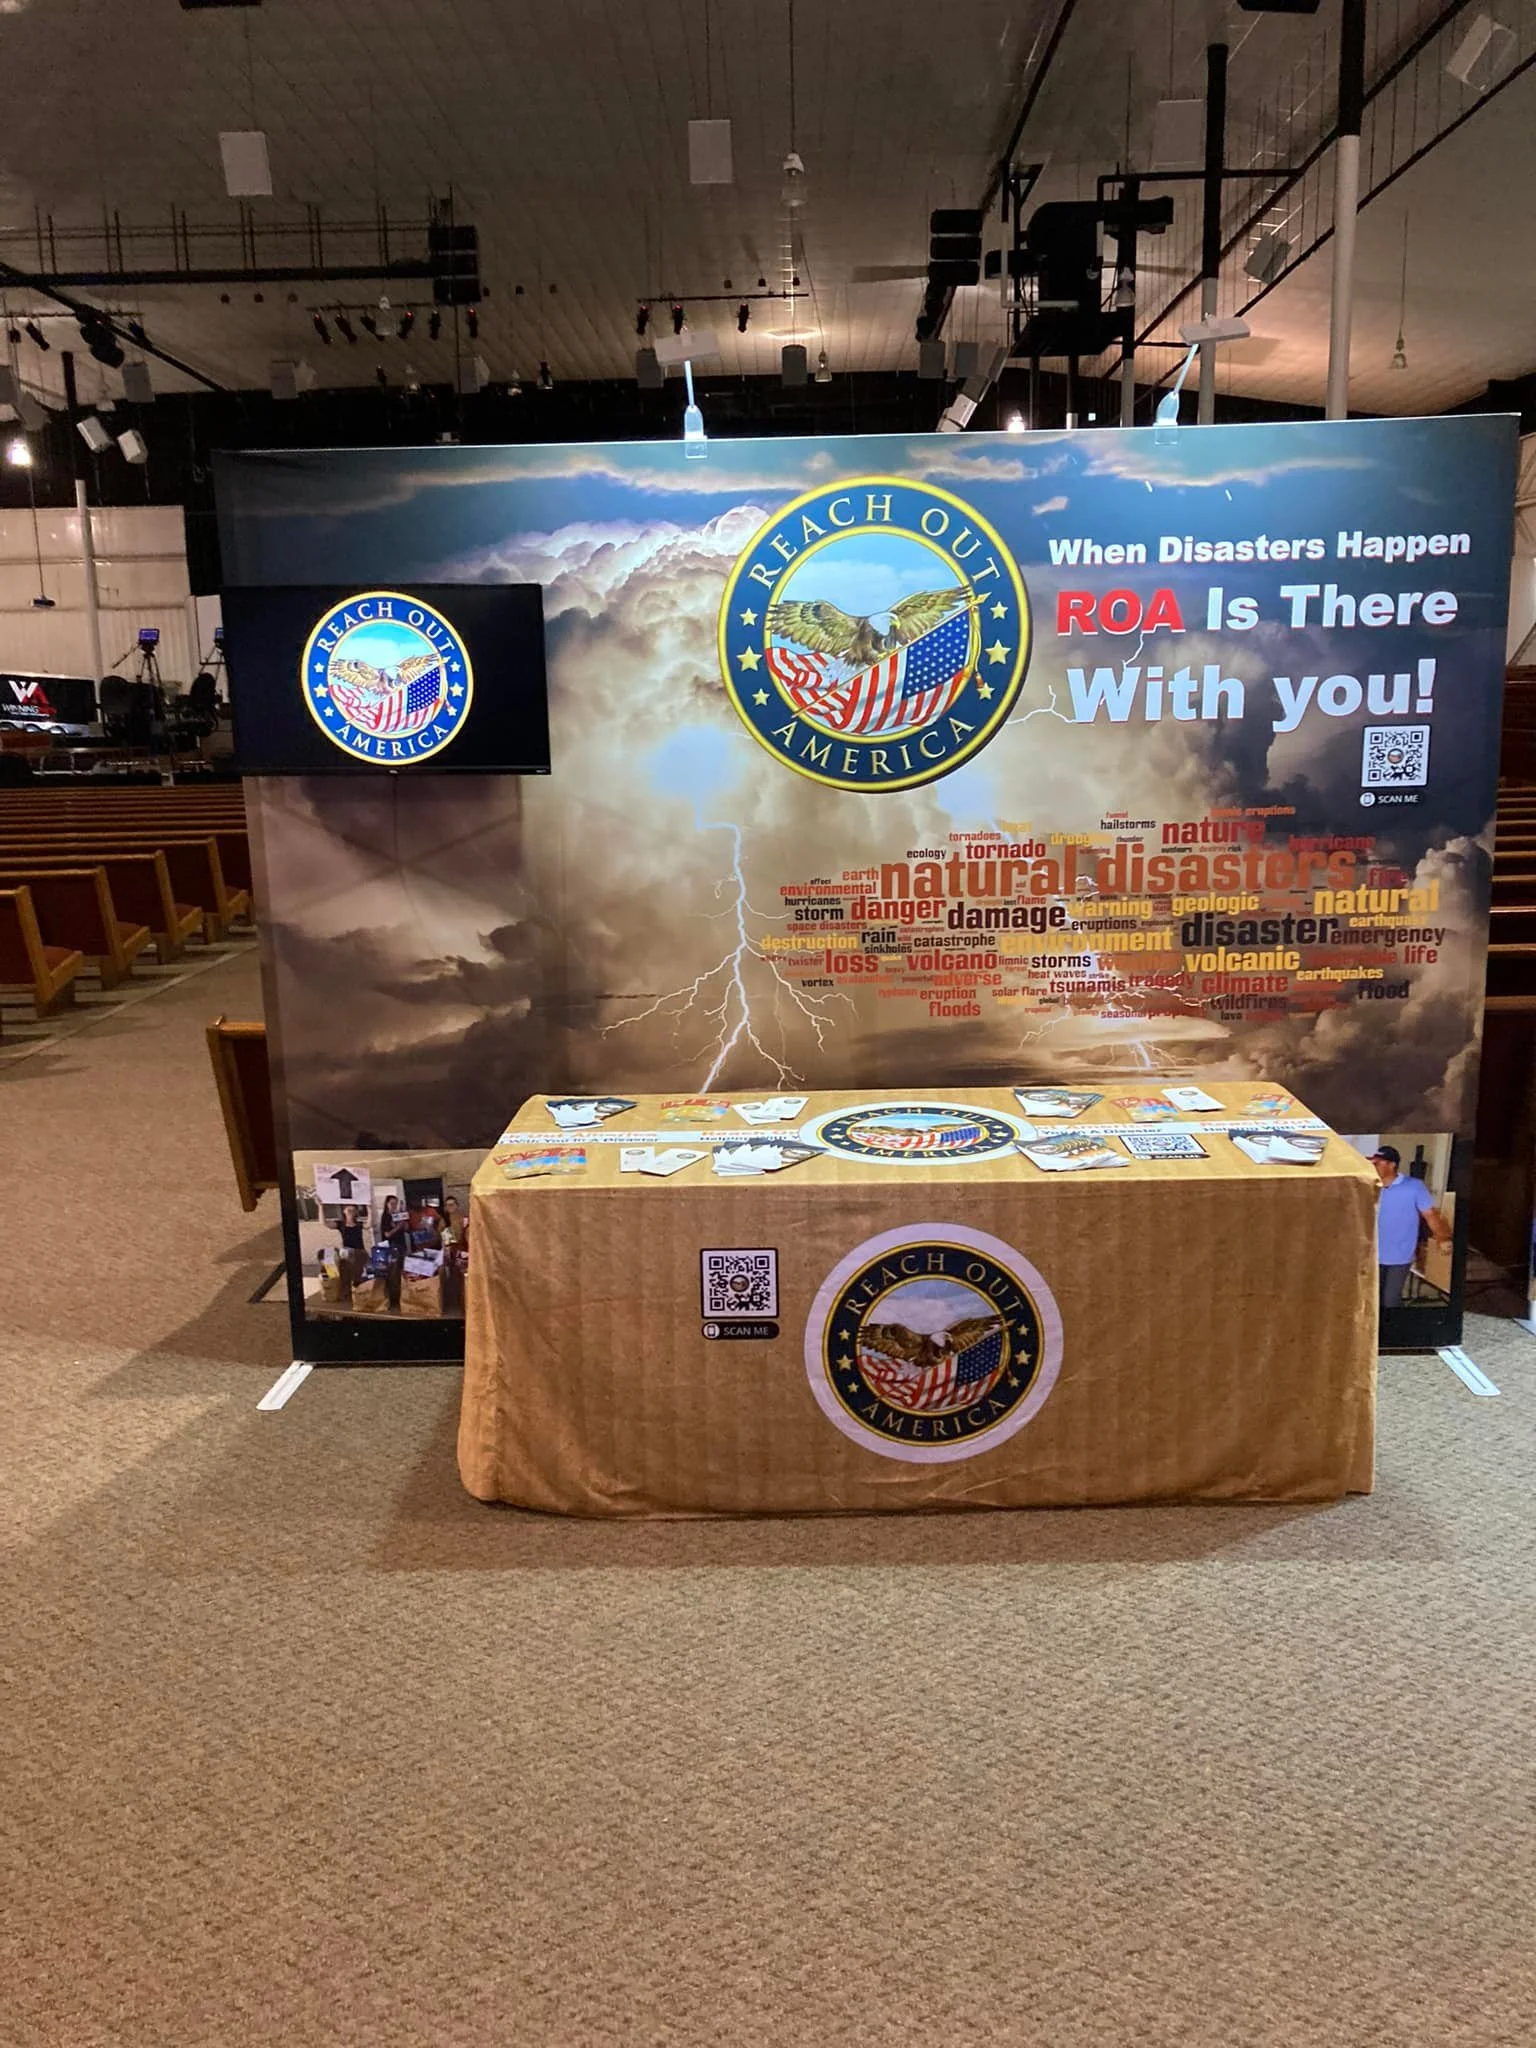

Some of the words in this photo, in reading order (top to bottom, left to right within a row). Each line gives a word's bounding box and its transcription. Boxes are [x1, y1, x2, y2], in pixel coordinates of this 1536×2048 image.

[749, 494, 893, 589] REACH
[921, 508, 1000, 585] OUT
[1049, 538, 1147, 566] When
[1159, 533, 1326, 564] Disasters
[1337, 530, 1470, 563] Happen
[1056, 588, 1186, 637] ROA
[1207, 587, 1259, 632] Is
[1280, 584, 1459, 629] There
[317, 601, 394, 653] REACH
[408, 609, 455, 652] OUT
[1066, 664, 1245, 724] With
[1272, 658, 1436, 733] you!
[337, 725, 448, 757] AMERICA
[770, 716, 976, 775] AMERICA
[1378, 795, 1402, 804] SCAN
[1404, 794, 1419, 803] ME
[1100, 819, 1156, 830] hailstorms
[1162, 816, 1265, 844] nature
[949, 830, 1001, 841] tornadoes
[906, 848, 946, 859] ecology
[965, 838, 1047, 859] tornado
[842, 866, 879, 881] earth
[881, 845, 1077, 899] natural
[1096, 843, 1357, 893] disasters
[780, 881, 877, 896] environmental
[1314, 880, 1440, 914] natural
[784, 895, 841, 906] hurricanes
[850, 895, 947, 925] danger
[1069, 897, 1153, 920] warning
[1172, 891, 1260, 917] geologic
[795, 906, 844, 921] storm
[948, 901, 1066, 934] damage
[1071, 917, 1138, 932] eruptions
[1182, 911, 1338, 947] disaster
[761, 932, 859, 950] destruction
[861, 928, 897, 943] rain
[914, 933, 996, 949] catastrophe
[1000, 926, 1174, 953] environment
[1330, 928, 1445, 947] emergency
[864, 943, 912, 954] sinkholes
[1405, 945, 1437, 964] life
[826, 949, 880, 974] loss
[907, 948, 999, 971] volcano
[1031, 953, 1091, 968] storms
[1184, 945, 1300, 973] volcanic
[801, 977, 834, 987] vortex
[933, 971, 1002, 987] adverse
[1028, 970, 1051, 980] heat
[1054, 970, 1087, 979] waves
[1201, 971, 1289, 995] climate
[1296, 966, 1384, 982] earthquakes
[920, 986, 977, 1001] eruption
[992, 987, 1019, 997] solar
[1022, 986, 1048, 996] flare
[1050, 976, 1126, 993] tsunamis
[1358, 979, 1410, 999] flood
[929, 1001, 981, 1017] floods
[837, 1107, 922, 1125] REACH
[941, 1110, 997, 1127] OUT
[854, 1144, 992, 1158] AMERICA
[845, 1252, 945, 1315] REACH
[966, 1263, 1024, 1313] OUT
[723, 1327, 751, 1336] SCAN
[754, 1327, 769, 1336] ME
[861, 1399, 1008, 1438] AMERICA
